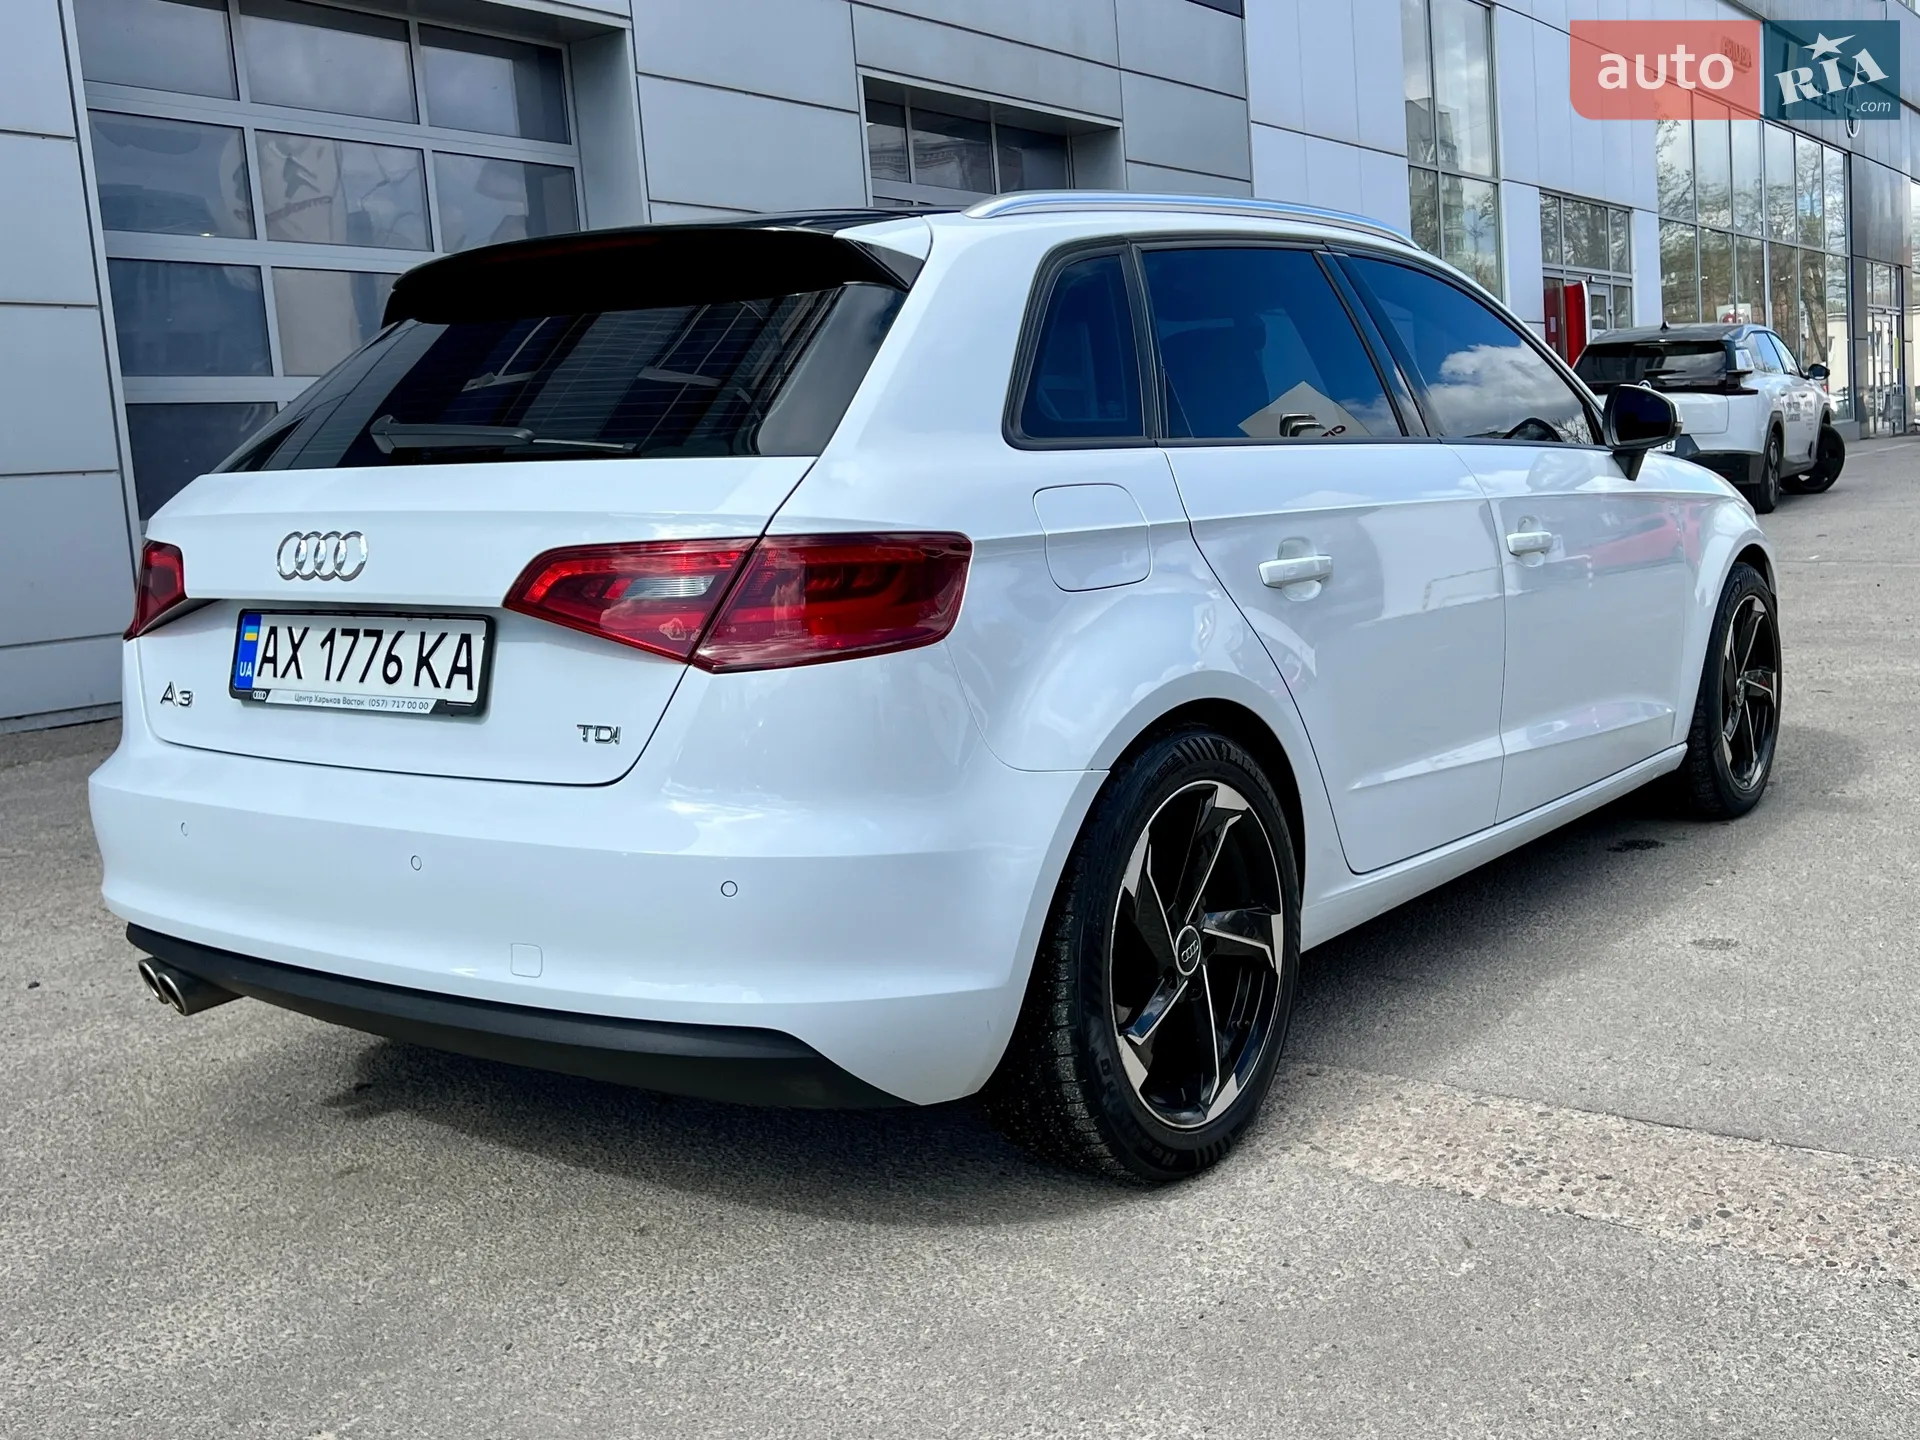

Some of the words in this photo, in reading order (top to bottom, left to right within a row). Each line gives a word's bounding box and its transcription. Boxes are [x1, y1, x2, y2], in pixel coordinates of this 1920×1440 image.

[256, 625, 310, 680] AX
[319, 627, 406, 686] 1776
[413, 630, 475, 691] KA
[239, 661, 253, 678] UA
[160, 681, 194, 708] A3
[294, 694, 313, 704] Центр
[314, 695, 341, 705] Харьков
[342, 696, 365, 706] Восток
[368, 699, 388, 709] (057)
[391, 700, 406, 709] 717
[407, 701, 417, 709] 00
[418, 701, 429, 710] 00
[576, 724, 621, 745] TDI
